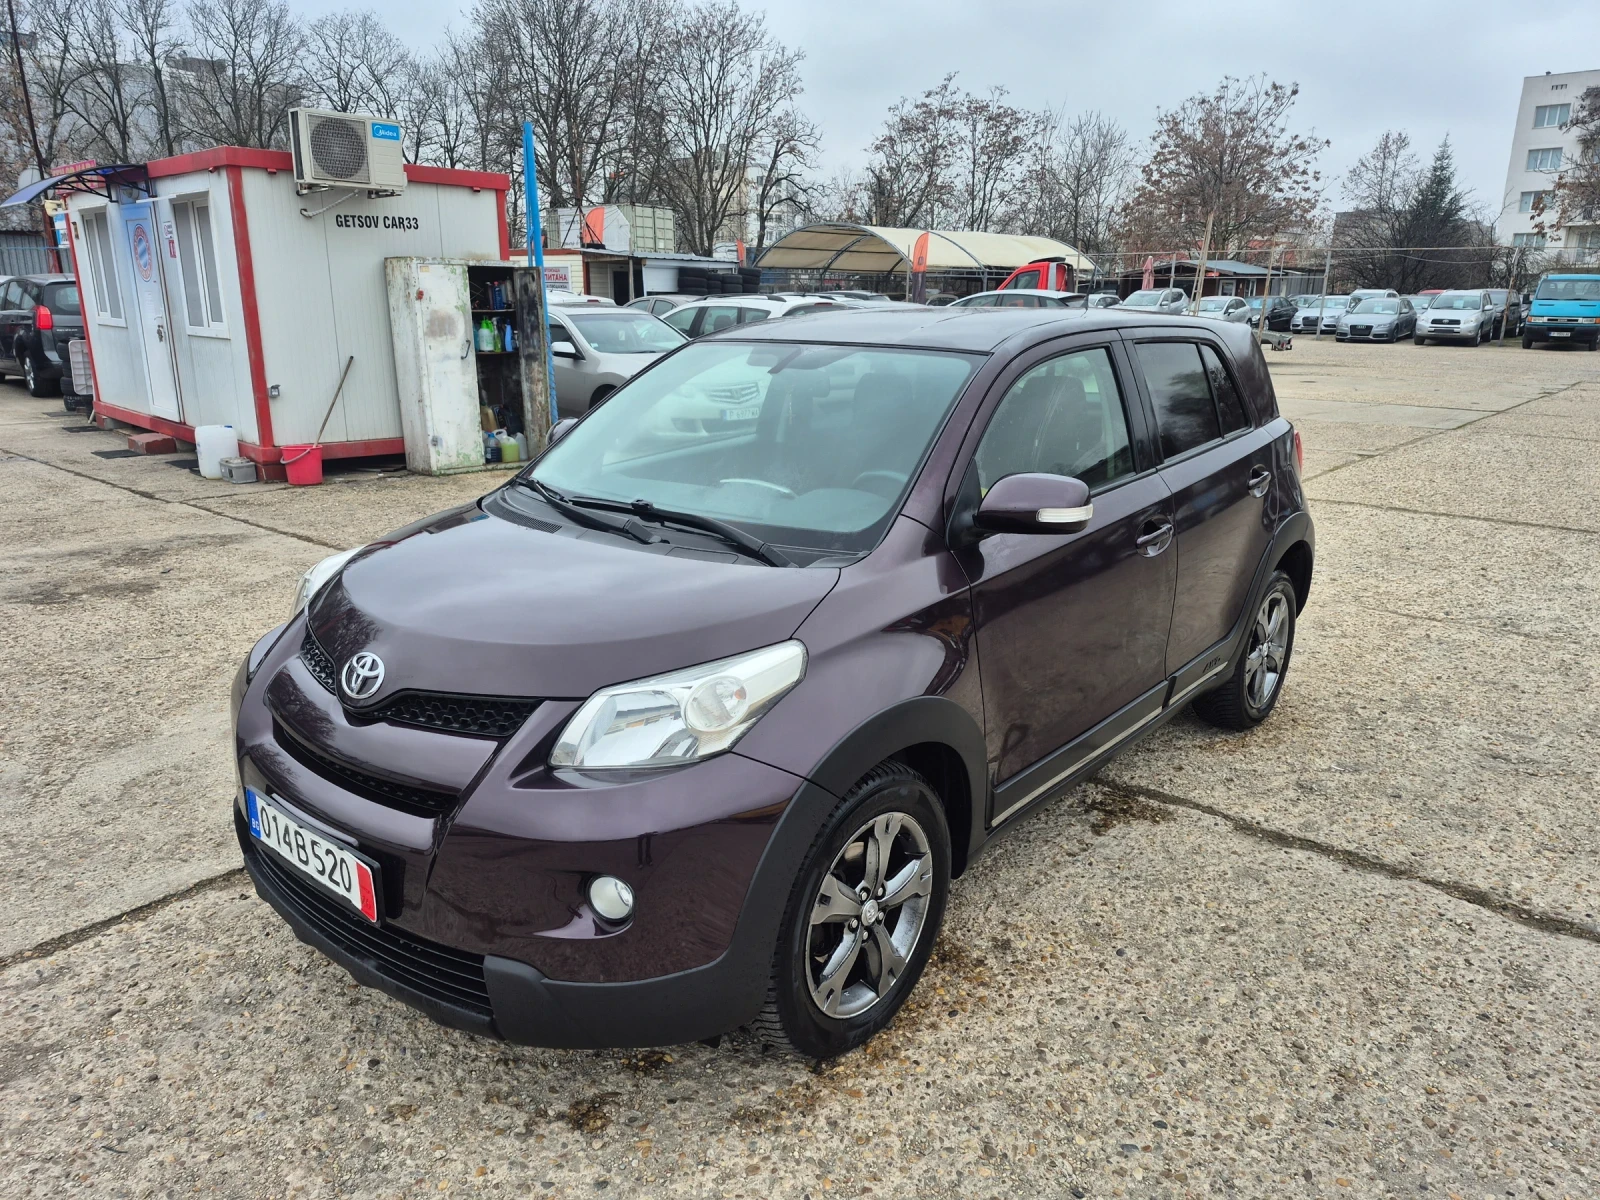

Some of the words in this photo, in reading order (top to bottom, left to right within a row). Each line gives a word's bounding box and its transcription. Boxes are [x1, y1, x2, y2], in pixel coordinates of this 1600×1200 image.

[373, 125, 397, 137] Midea
[335, 214, 379, 229] GETSOV
[383, 216, 419, 230] CAR33
[544, 273, 568, 281] ПИТАНА
[252, 817, 260, 831] BG
